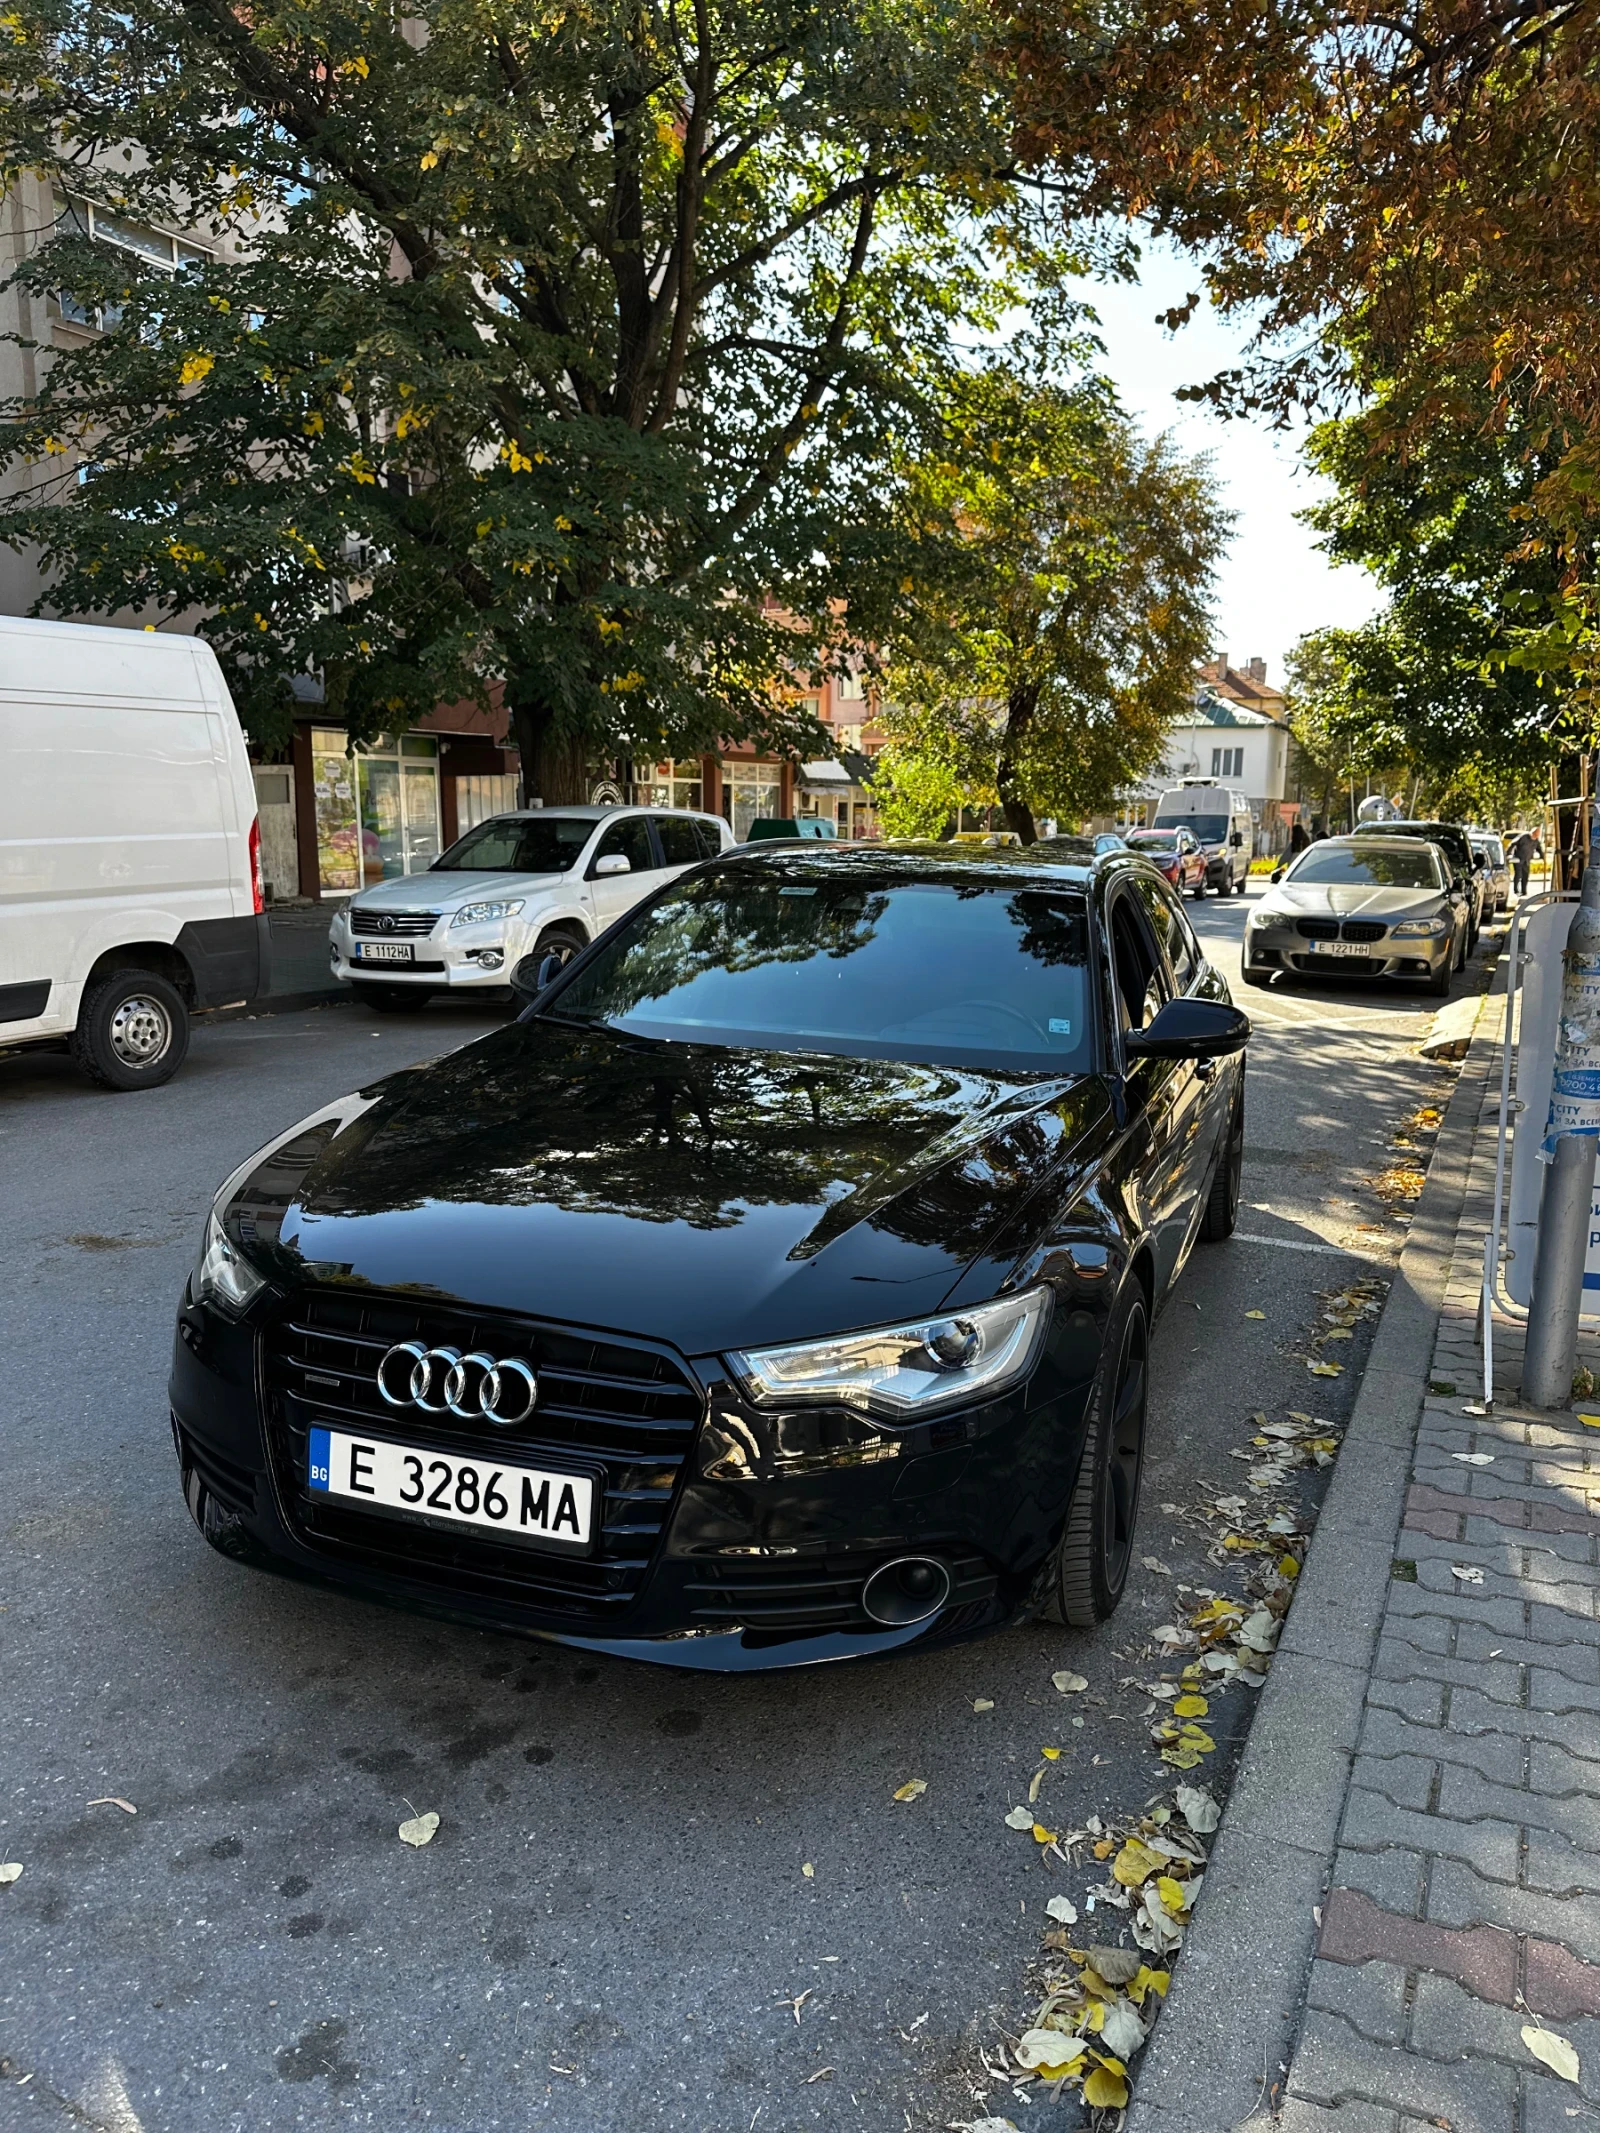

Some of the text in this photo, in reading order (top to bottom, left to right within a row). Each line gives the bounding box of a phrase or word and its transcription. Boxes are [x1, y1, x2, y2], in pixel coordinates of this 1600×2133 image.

[365, 945, 371, 957] E
[1319, 943, 1325, 952] E
[1574, 984, 1600, 995] CITY
[1556, 1104, 1581, 1115] CITY
[311, 1465, 328, 1482] BG
[350, 1443, 580, 1535] E 3286 MA
